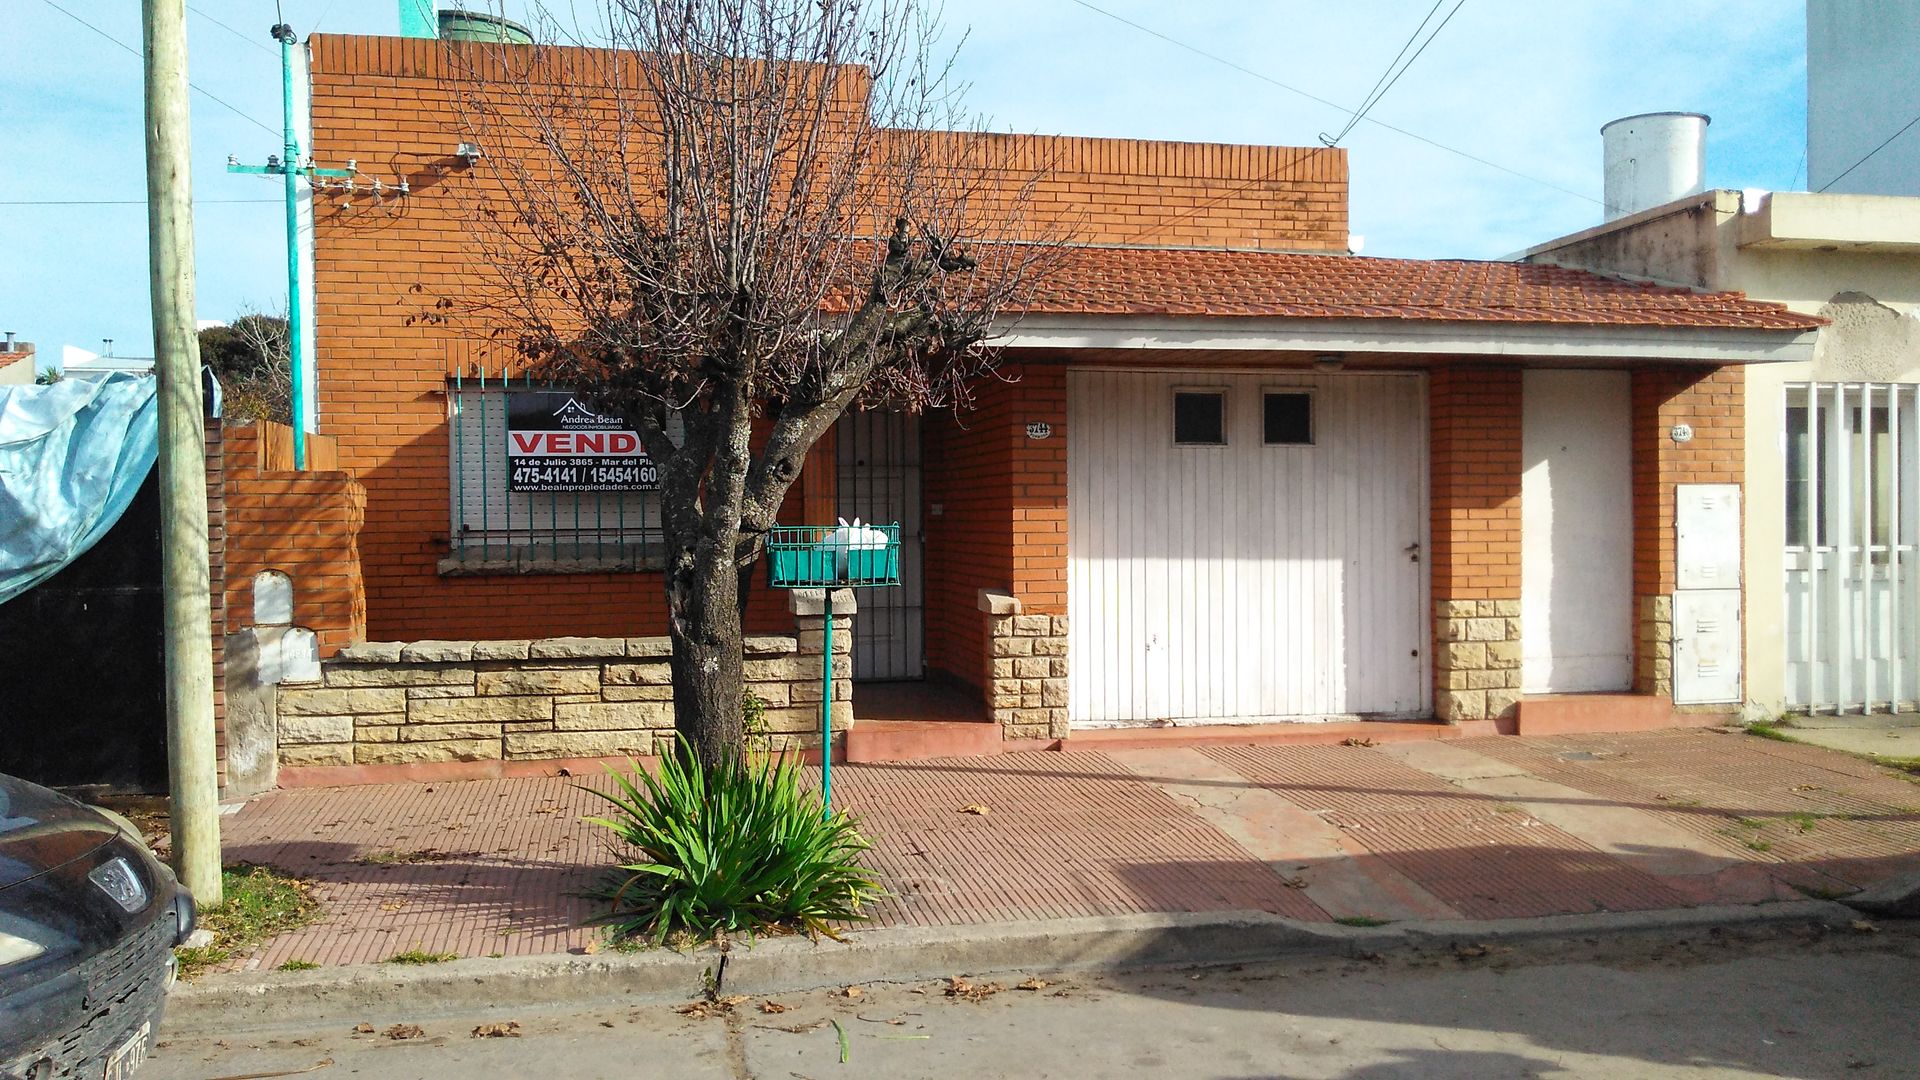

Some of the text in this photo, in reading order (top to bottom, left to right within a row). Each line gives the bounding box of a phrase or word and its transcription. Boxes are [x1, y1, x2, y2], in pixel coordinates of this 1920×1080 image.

[560, 415, 595, 424] Andrea
[512, 434, 647, 453] VEND
[513, 467, 577, 482] 475-4141
[582, 467, 587, 483] /
